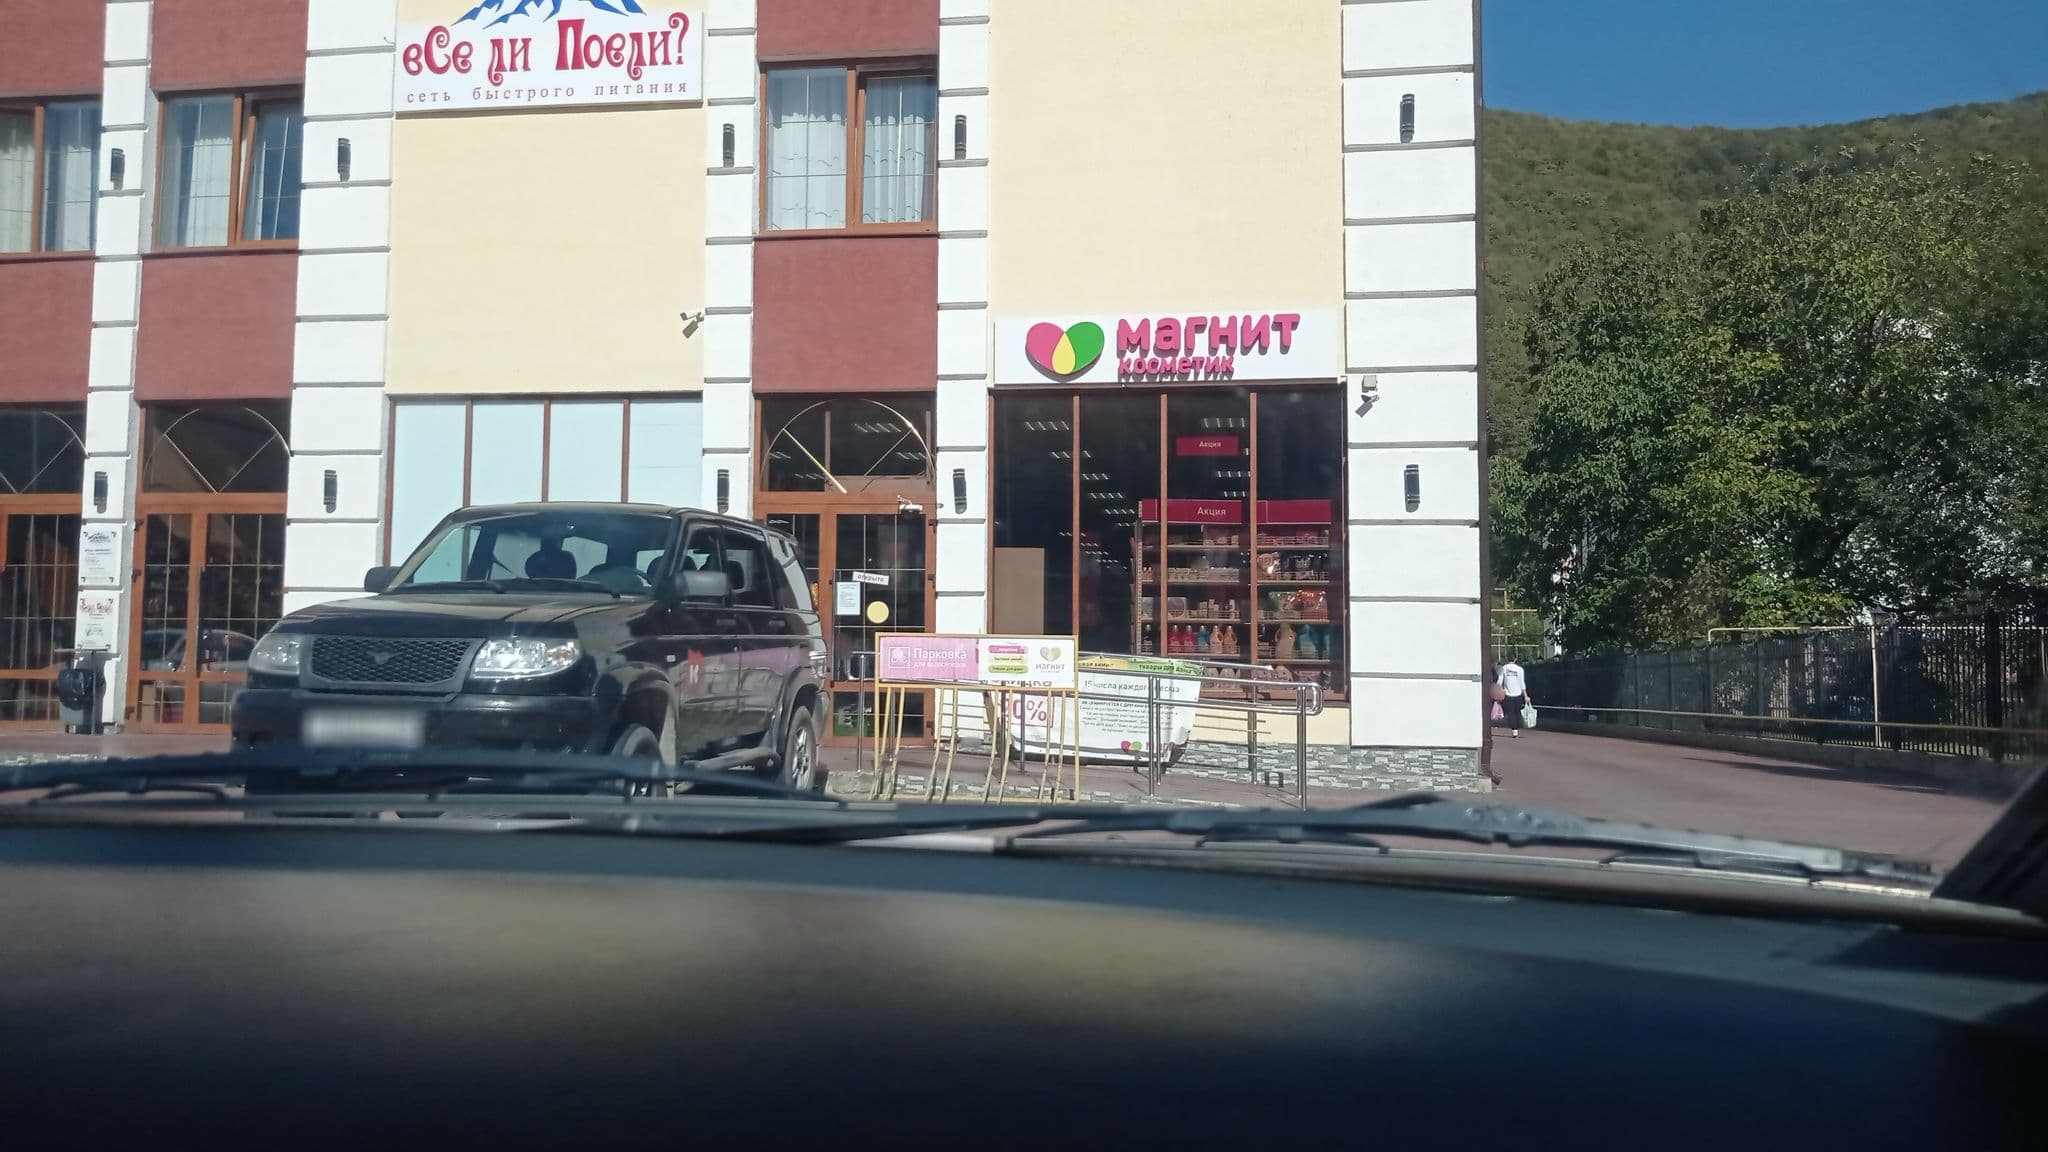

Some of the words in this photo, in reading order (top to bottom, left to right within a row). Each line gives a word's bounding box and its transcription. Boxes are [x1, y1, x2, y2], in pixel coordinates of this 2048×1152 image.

[555, 11, 690, 81] Поели?
[407, 91, 451, 103] сеть
[472, 86, 575, 102] быстрого
[594, 82, 688, 97] питания
[1118, 356, 1235, 378] косметик
[1199, 440, 1221, 448] Акция
[1197, 506, 1226, 516] Акция
[913, 647, 967, 661] Парковка
[1118, 683, 1147, 692] каждог
